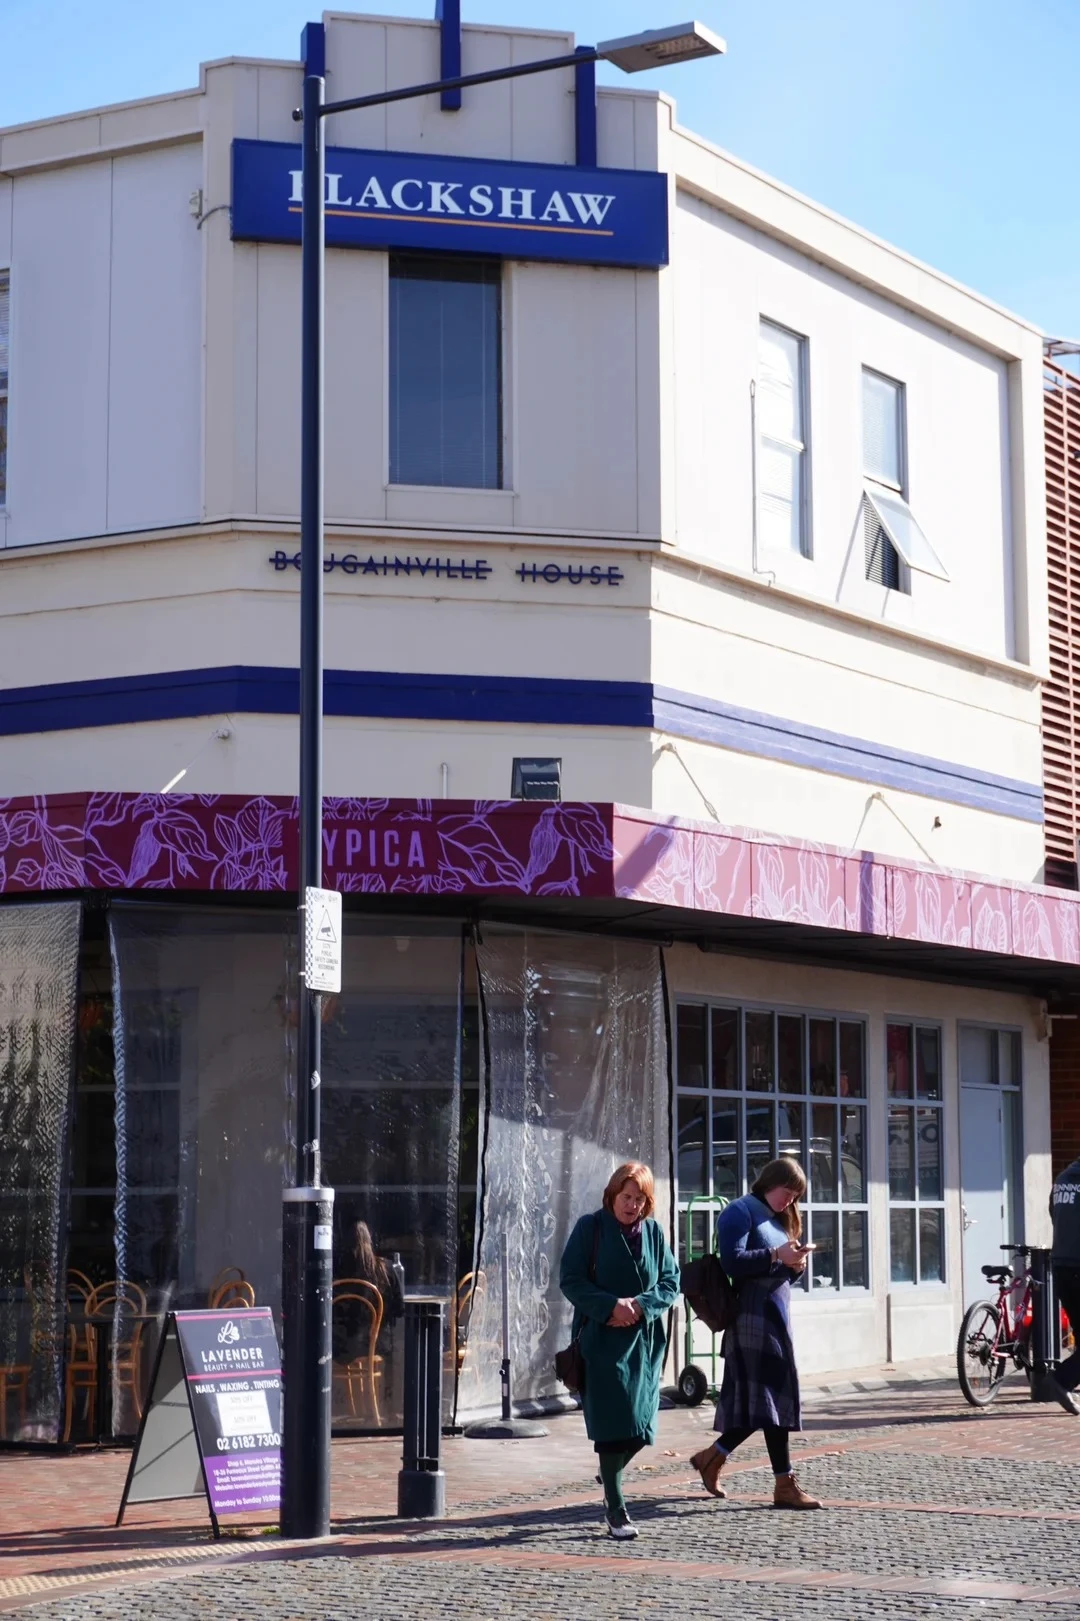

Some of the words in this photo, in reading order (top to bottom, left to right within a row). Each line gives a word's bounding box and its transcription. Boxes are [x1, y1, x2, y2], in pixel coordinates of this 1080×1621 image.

[518, 562, 621, 586] HOUSE
[298, 828, 426, 868] YPICA
[201, 1347, 264, 1363] LAVENDER
[203, 1363, 228, 1372] BEAUTY
[235, 1362, 251, 1370] NAIL
[252, 1361, 265, 1369] BAR
[195, 1383, 215, 1394] NAILS
[219, 1381, 249, 1392] WAXING
[253, 1379, 280, 1389] TINTING
[216, 1437, 230, 1451] 02
[232, 1435, 256, 1450] 6182
[257, 1433, 281, 1446] 7300
[214, 1498, 236, 1508] Monday
[236, 1497, 242, 1505] to
[242, 1495, 262, 1505] Sunday
